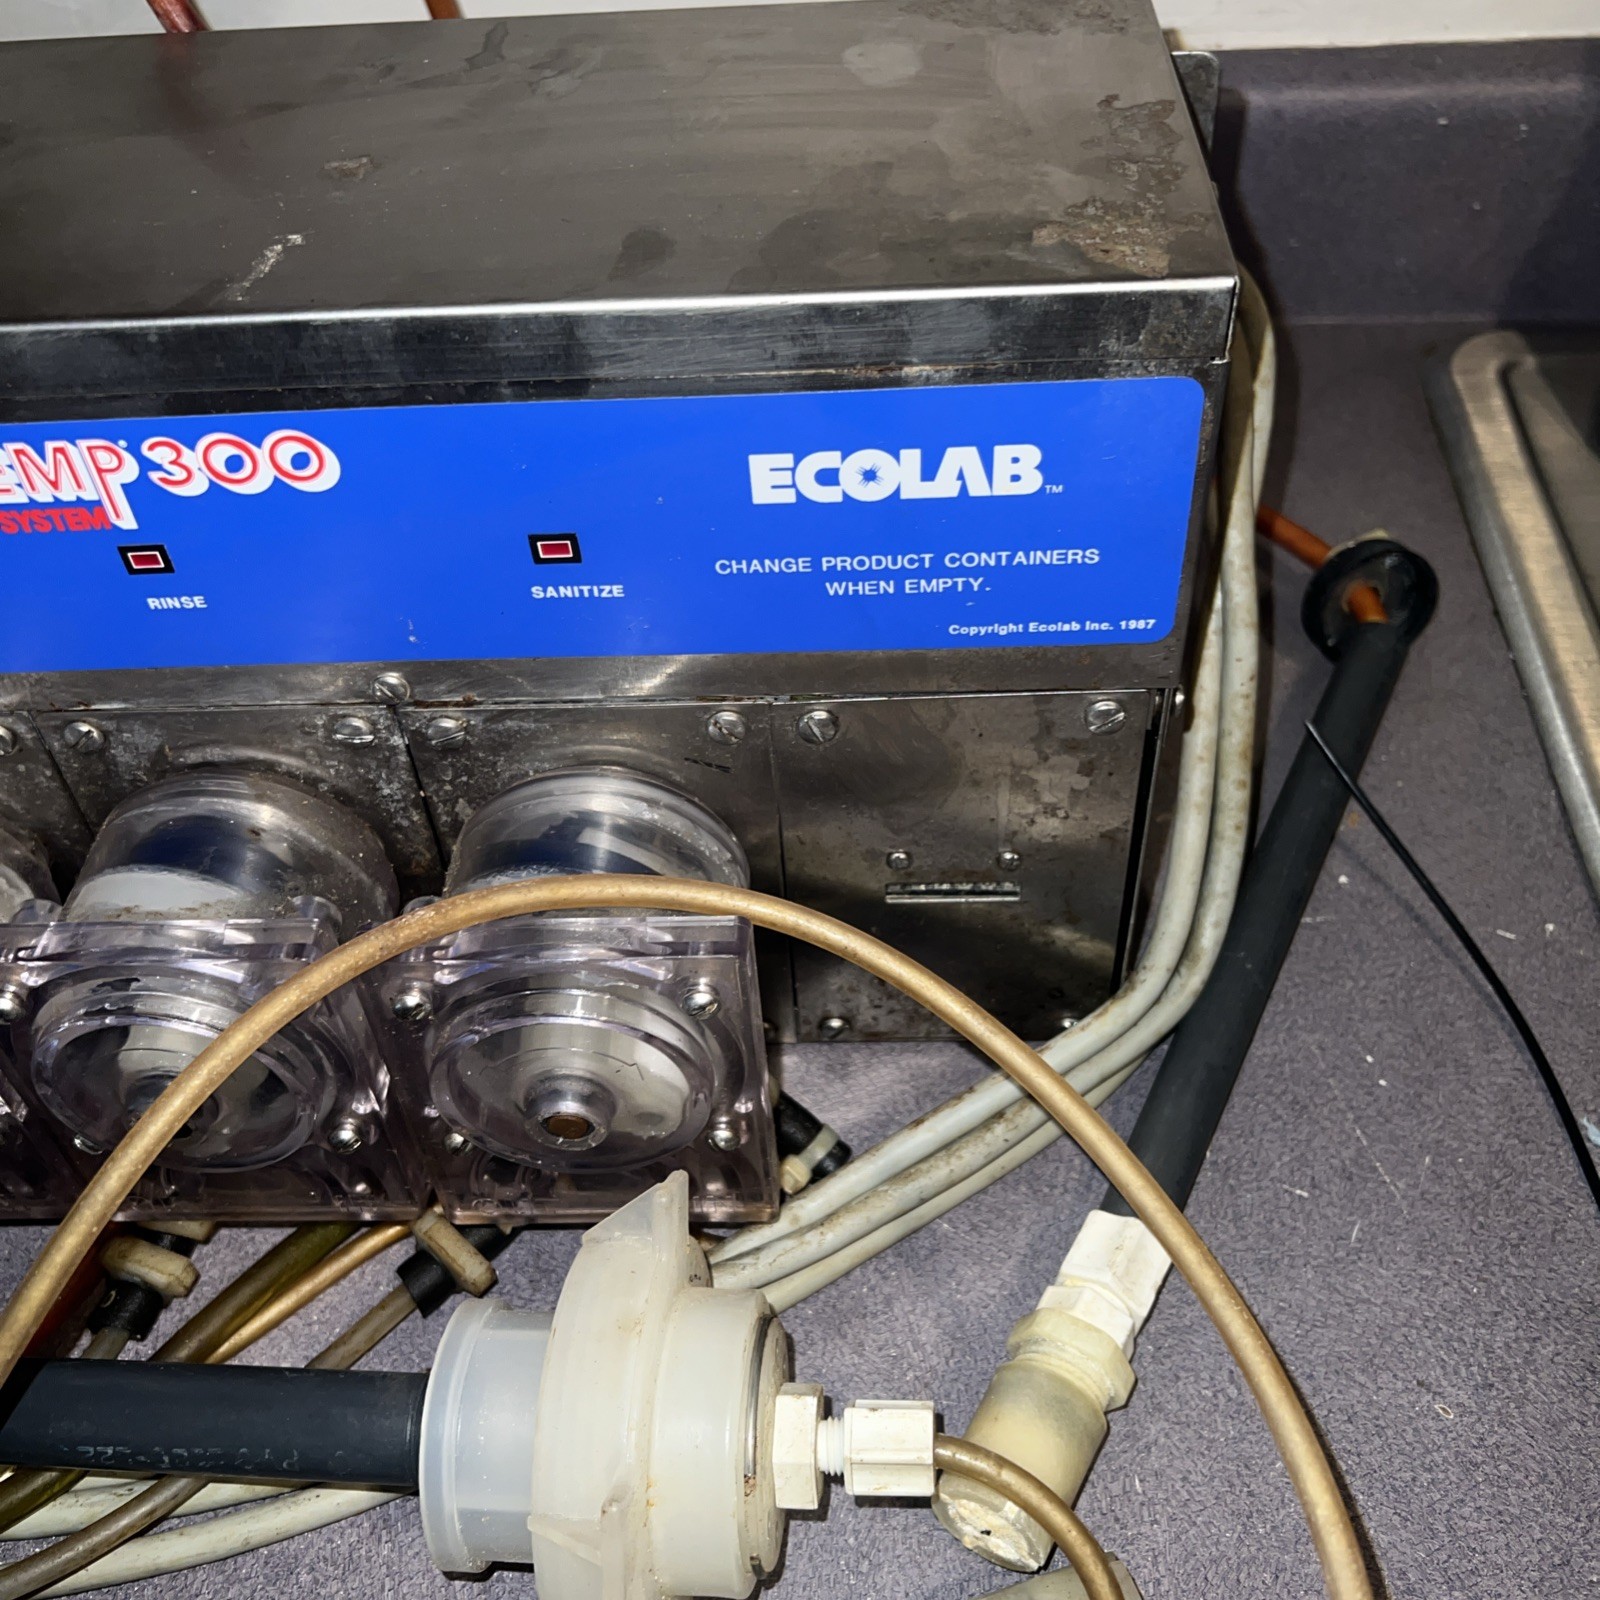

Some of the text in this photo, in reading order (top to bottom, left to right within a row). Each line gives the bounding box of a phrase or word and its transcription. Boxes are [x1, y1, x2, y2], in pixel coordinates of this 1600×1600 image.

[141, 429, 341, 497] 300
[748, 443, 1043, 505] ECOLAB
[0, 506, 112, 534] SYSTEM
[715, 548, 1100, 575] CHANGE PRODUCT CONTAINERS
[532, 584, 625, 599] SANITIZE
[825, 577, 991, 596] WHEN EMPTY.
[146, 595, 208, 610] RINSE
[948, 618, 1157, 636] Copyright Ecolab Inc. 1987
